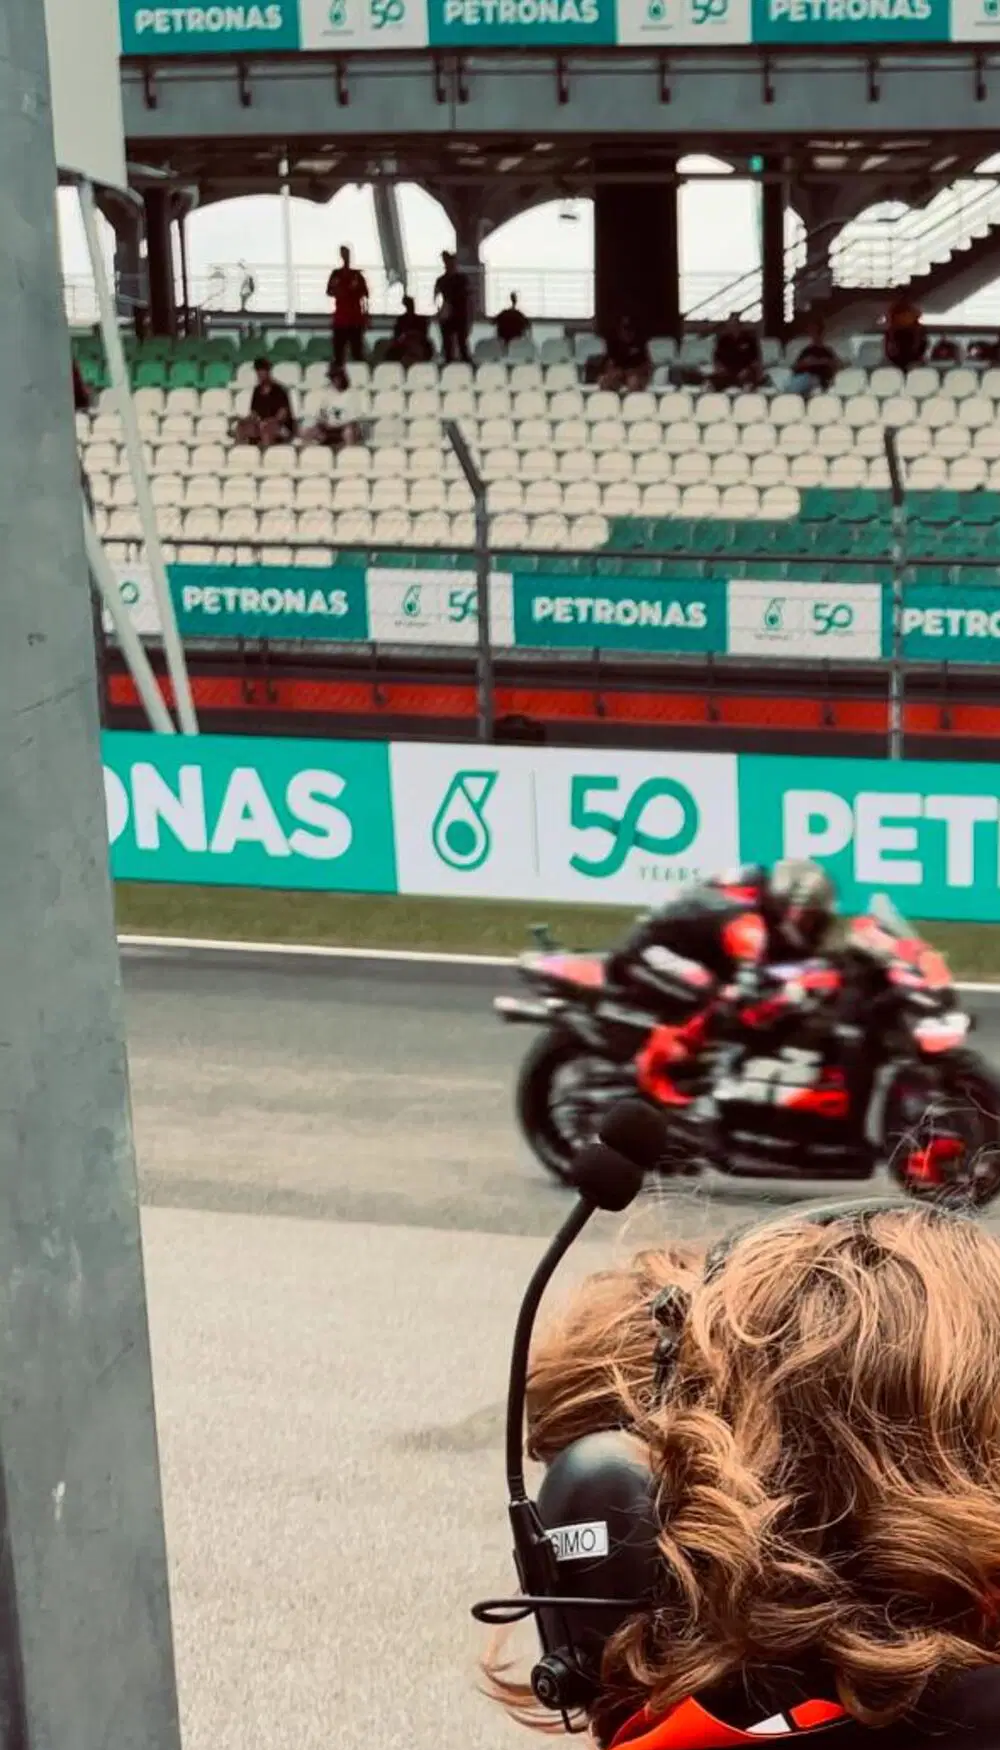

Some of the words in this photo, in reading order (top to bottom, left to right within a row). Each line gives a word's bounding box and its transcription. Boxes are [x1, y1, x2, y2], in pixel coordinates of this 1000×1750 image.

[134, 4, 283, 34] PETRONAS
[443, 0, 599, 25] PETRONAS
[182, 585, 349, 617] PETRONAS
[531, 597, 708, 629] PETRONAS
[814, 603, 853, 635] 50
[569, 774, 699, 879] 50
